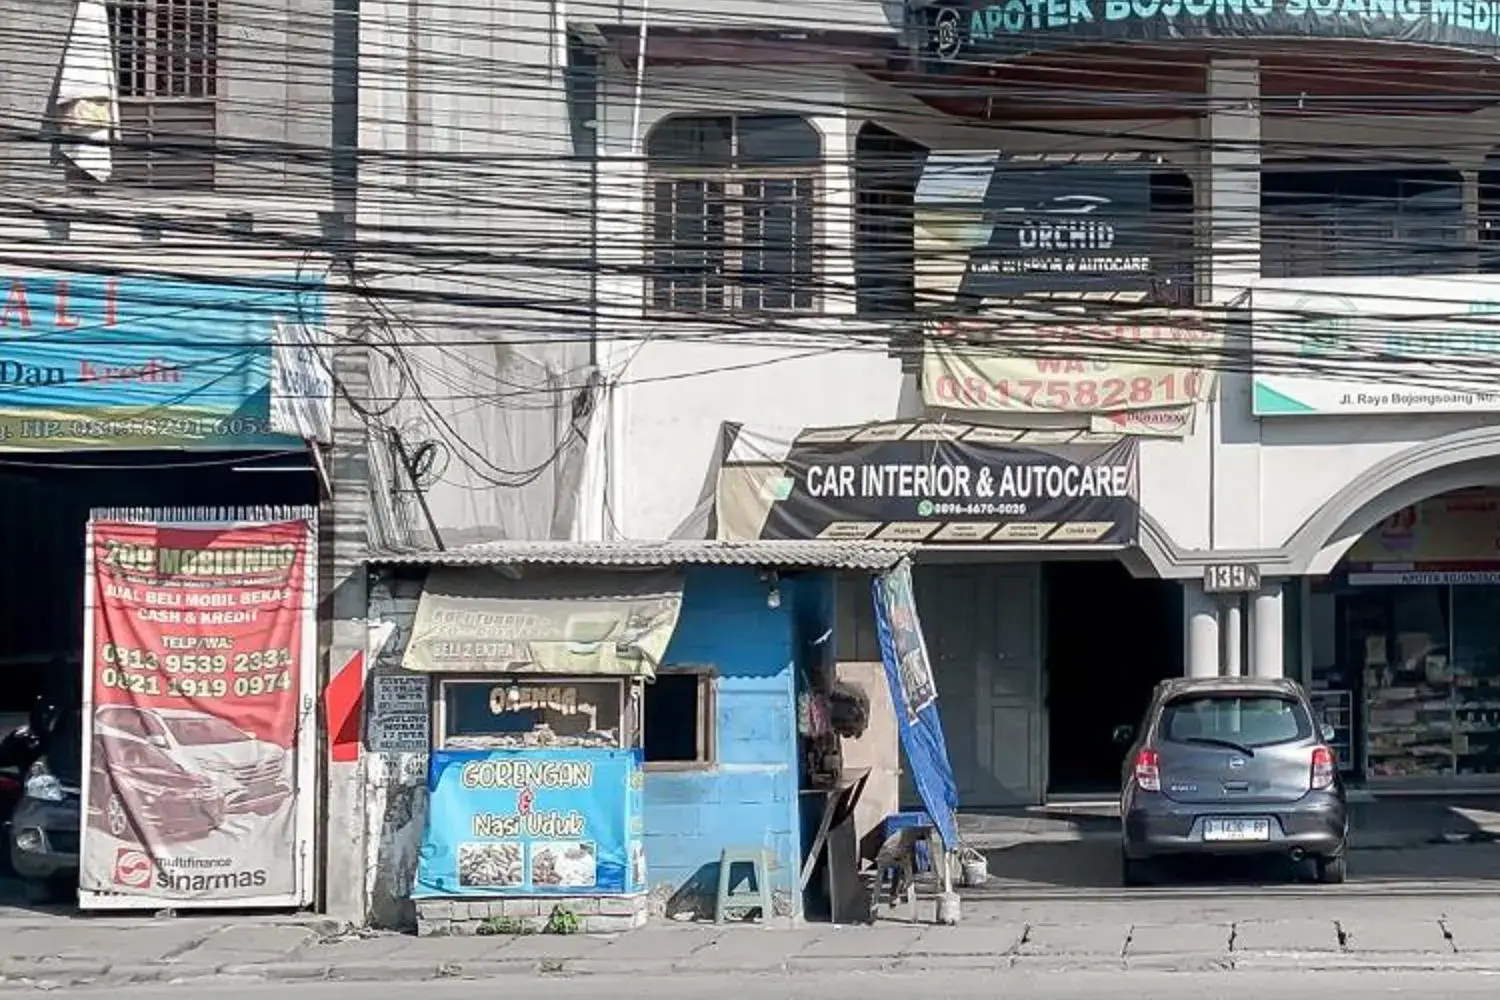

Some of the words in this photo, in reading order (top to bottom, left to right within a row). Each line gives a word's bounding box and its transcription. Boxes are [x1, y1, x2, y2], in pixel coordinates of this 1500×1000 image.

[1078, 256, 1150, 272] AUTOCARE
[1, 360, 66, 386] Dan
[1357, 393, 1389, 406] Raya
[1391, 392, 1474, 406] Bojongsoang
[806, 464, 857, 498] CAR
[861, 464, 971, 498] INTERIOR
[976, 465, 995, 498] &
[999, 464, 1127, 498] AUTOCARE
[105, 584, 142, 602] JUAL
[145, 590, 181, 606] BELI
[185, 590, 237, 607] MOBIL
[239, 588, 293, 606] BEKAS
[137, 607, 181, 624] CASH
[184, 612, 197, 625] &
[201, 609, 258, 625] KREDIT
[165, 653, 228, 674] 9539
[234, 671, 292, 697] 0974
[461, 759, 593, 791] GORENGAN
[473, 813, 523, 838] Nasi
[526, 811, 585, 838] Uduk
[155, 868, 268, 892] sinarmas
